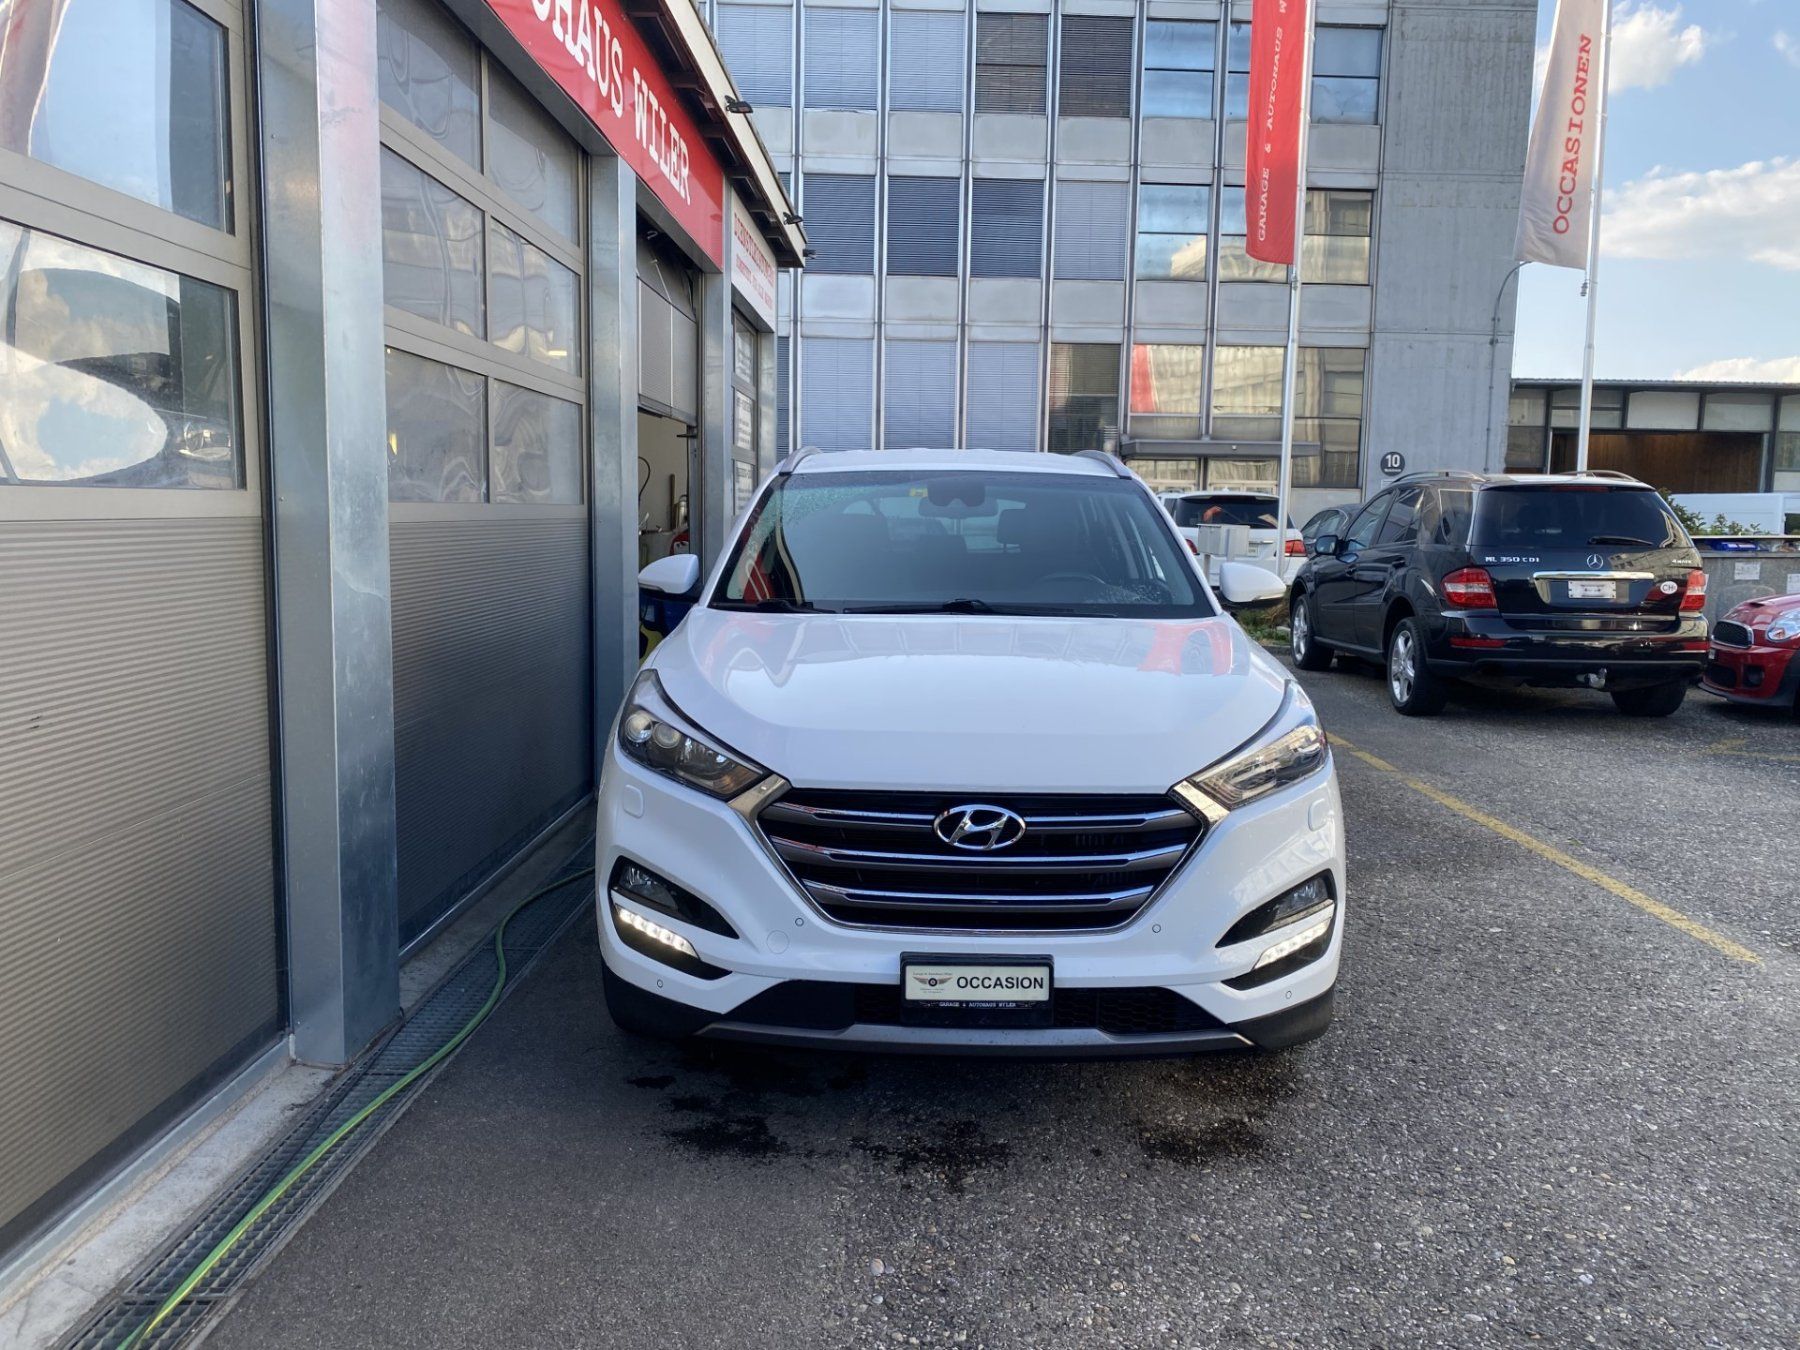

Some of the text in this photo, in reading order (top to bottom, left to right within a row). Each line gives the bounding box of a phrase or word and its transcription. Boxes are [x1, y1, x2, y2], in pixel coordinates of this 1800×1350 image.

[532, 0, 691, 206] HAUS WILER
[1267, 26, 1283, 131] AUTOHAUS
[1265, 143, 1272, 154] &
[1552, 33, 1592, 235] OCCASIONEN
[1259, 167, 1270, 242] GARAGE
[1385, 454, 1401, 468] 10
[956, 976, 1044, 990] OCCASION
